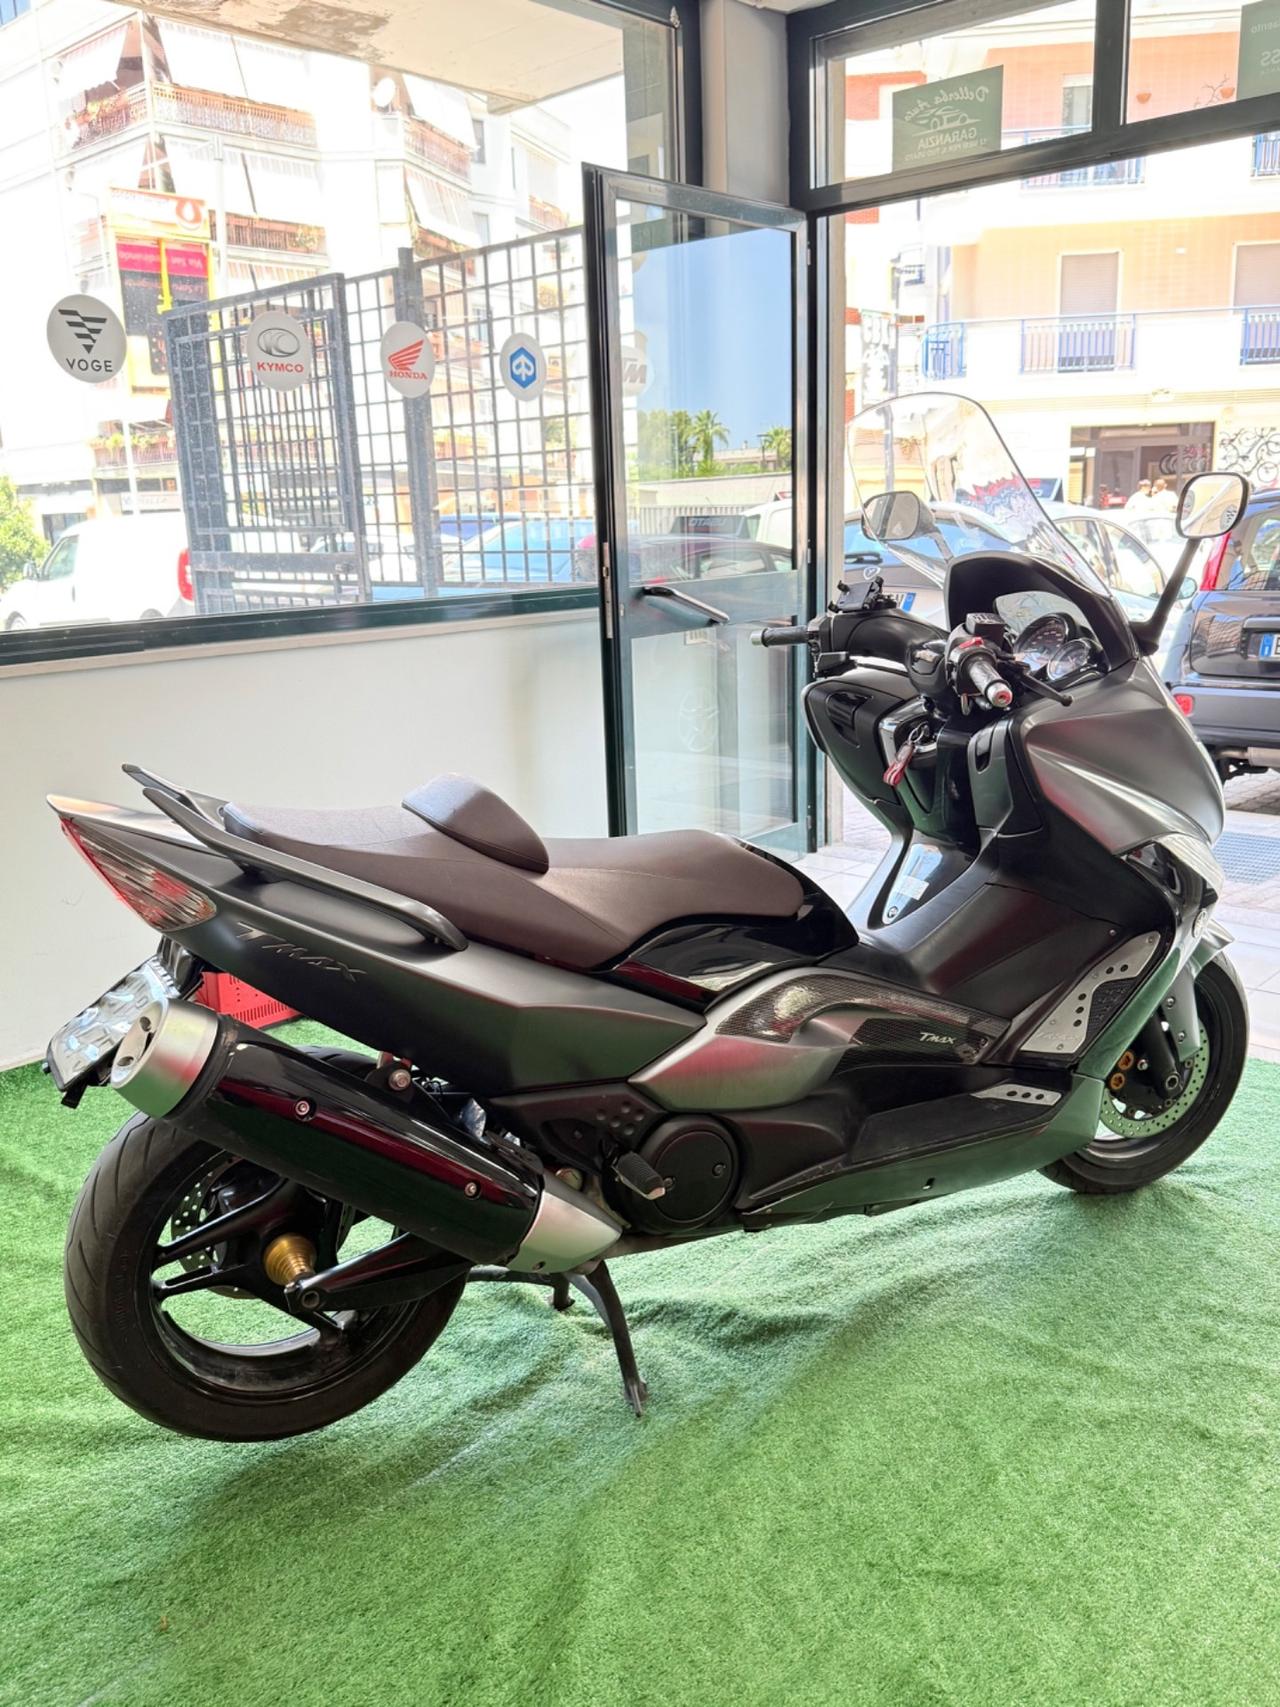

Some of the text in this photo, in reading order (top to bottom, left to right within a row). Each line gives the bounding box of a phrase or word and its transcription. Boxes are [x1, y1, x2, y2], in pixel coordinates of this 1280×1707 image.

[65, 357, 113, 373] VOGE
[257, 361, 304, 373] KYMCO
[390, 370, 428, 380] HONDA
